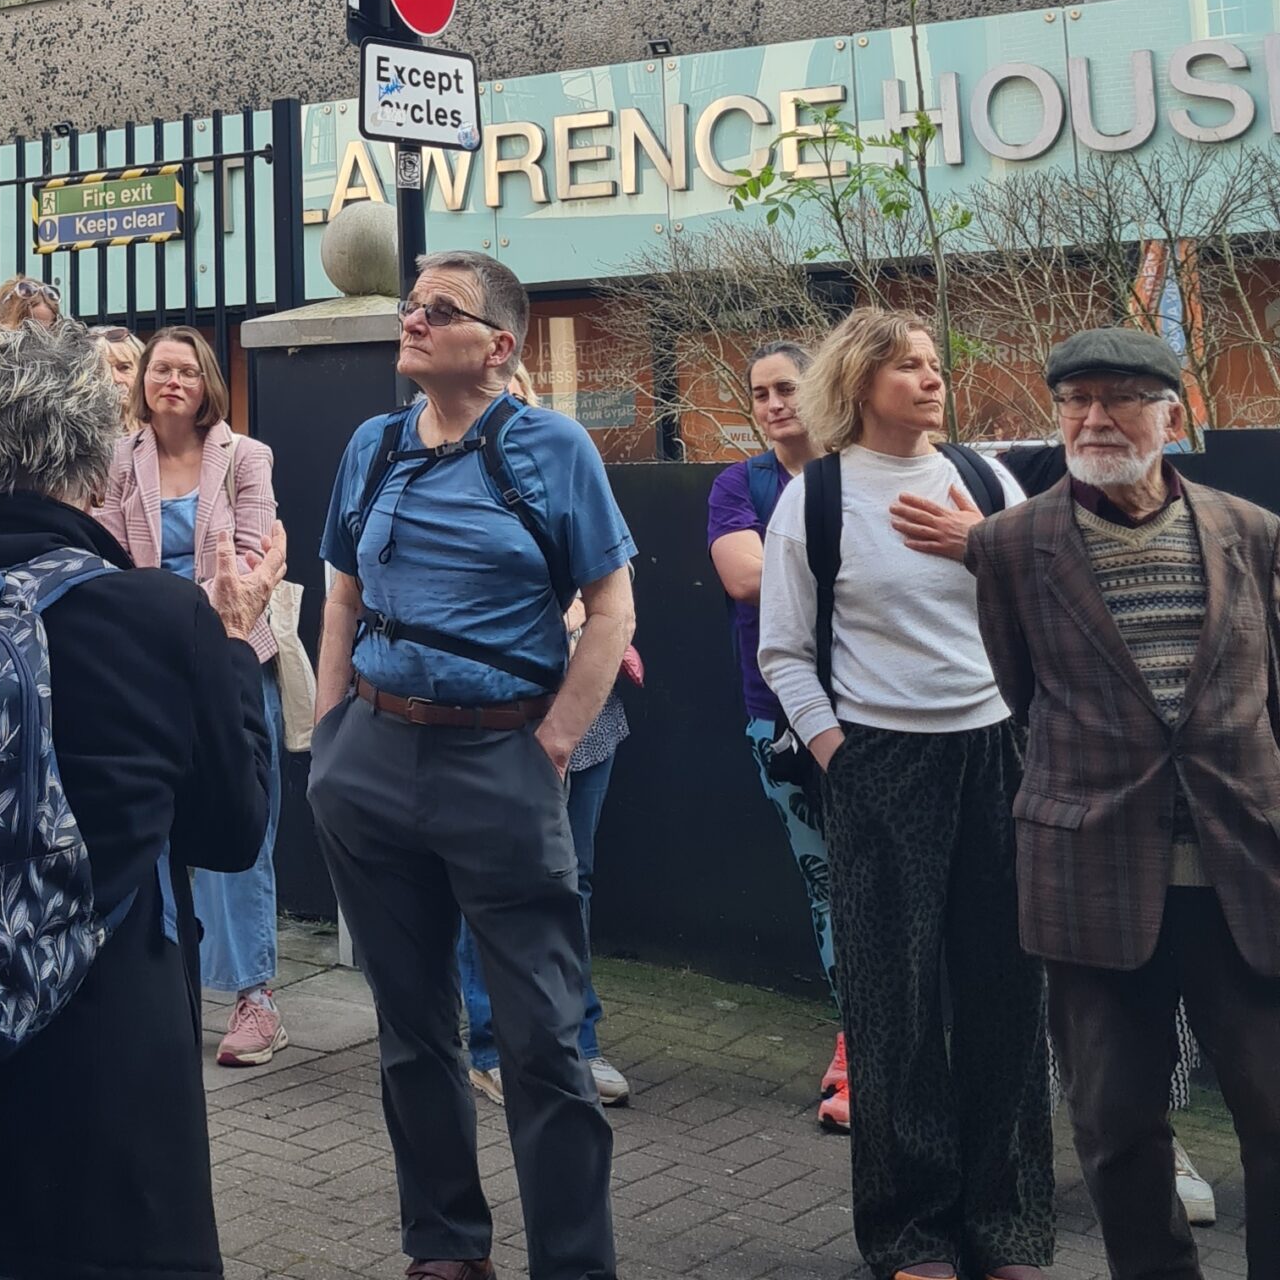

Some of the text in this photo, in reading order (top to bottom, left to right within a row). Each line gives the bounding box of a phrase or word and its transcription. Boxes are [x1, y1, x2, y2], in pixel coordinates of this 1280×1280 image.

[376, 55, 464, 95] Except
[303, 33, 1280, 222] AWRENCE HOUS
[82, 182, 153, 208] Fire exit
[75, 210, 166, 236] Keep clear
